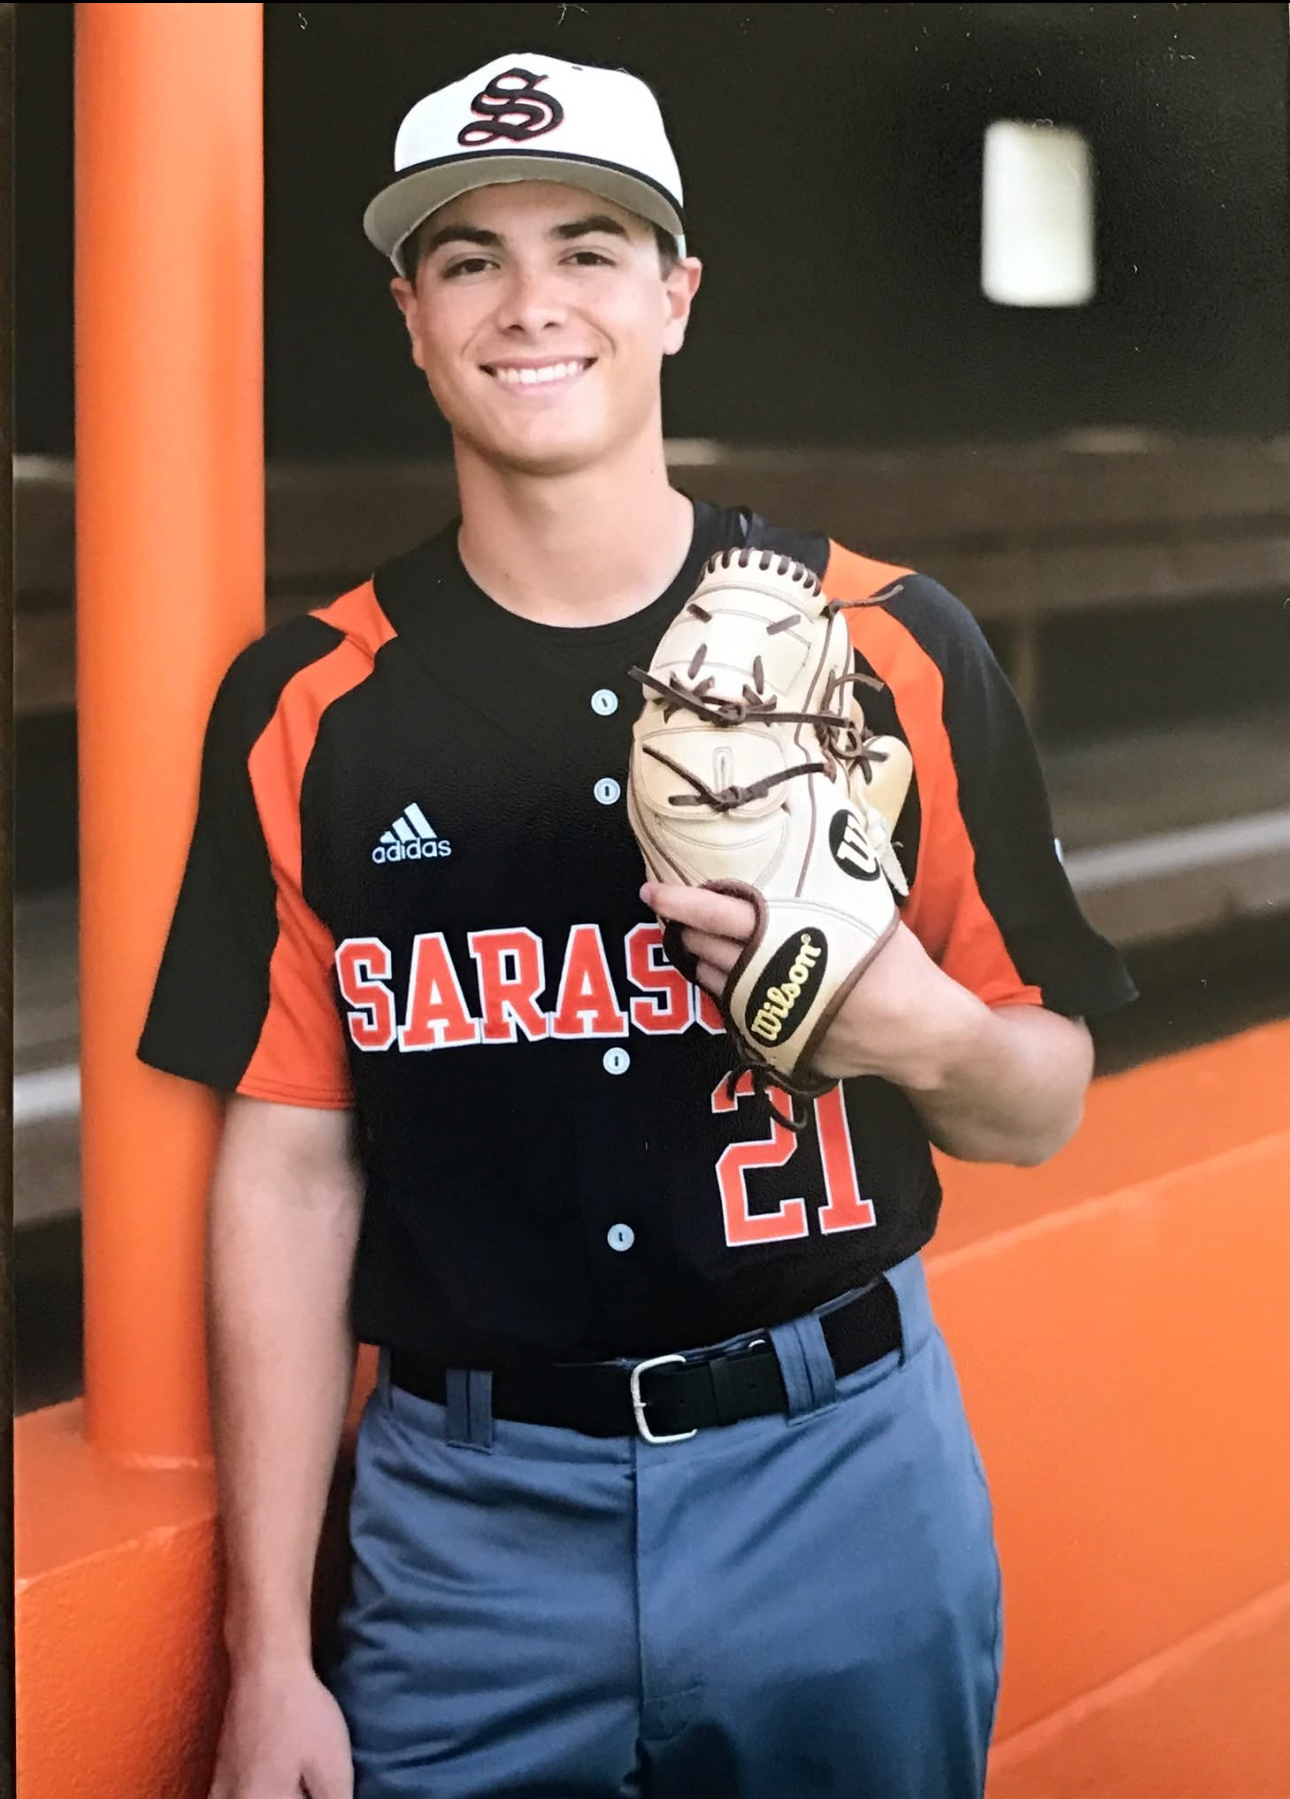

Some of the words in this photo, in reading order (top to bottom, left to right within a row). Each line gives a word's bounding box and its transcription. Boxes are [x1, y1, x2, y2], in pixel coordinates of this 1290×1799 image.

[457, 67, 565, 147] S
[372, 837, 452, 864] adidas
[335, 922, 727, 1052] SARAS
[751, 942, 822, 1042] Wilson
[711, 1069, 877, 1247] 21
